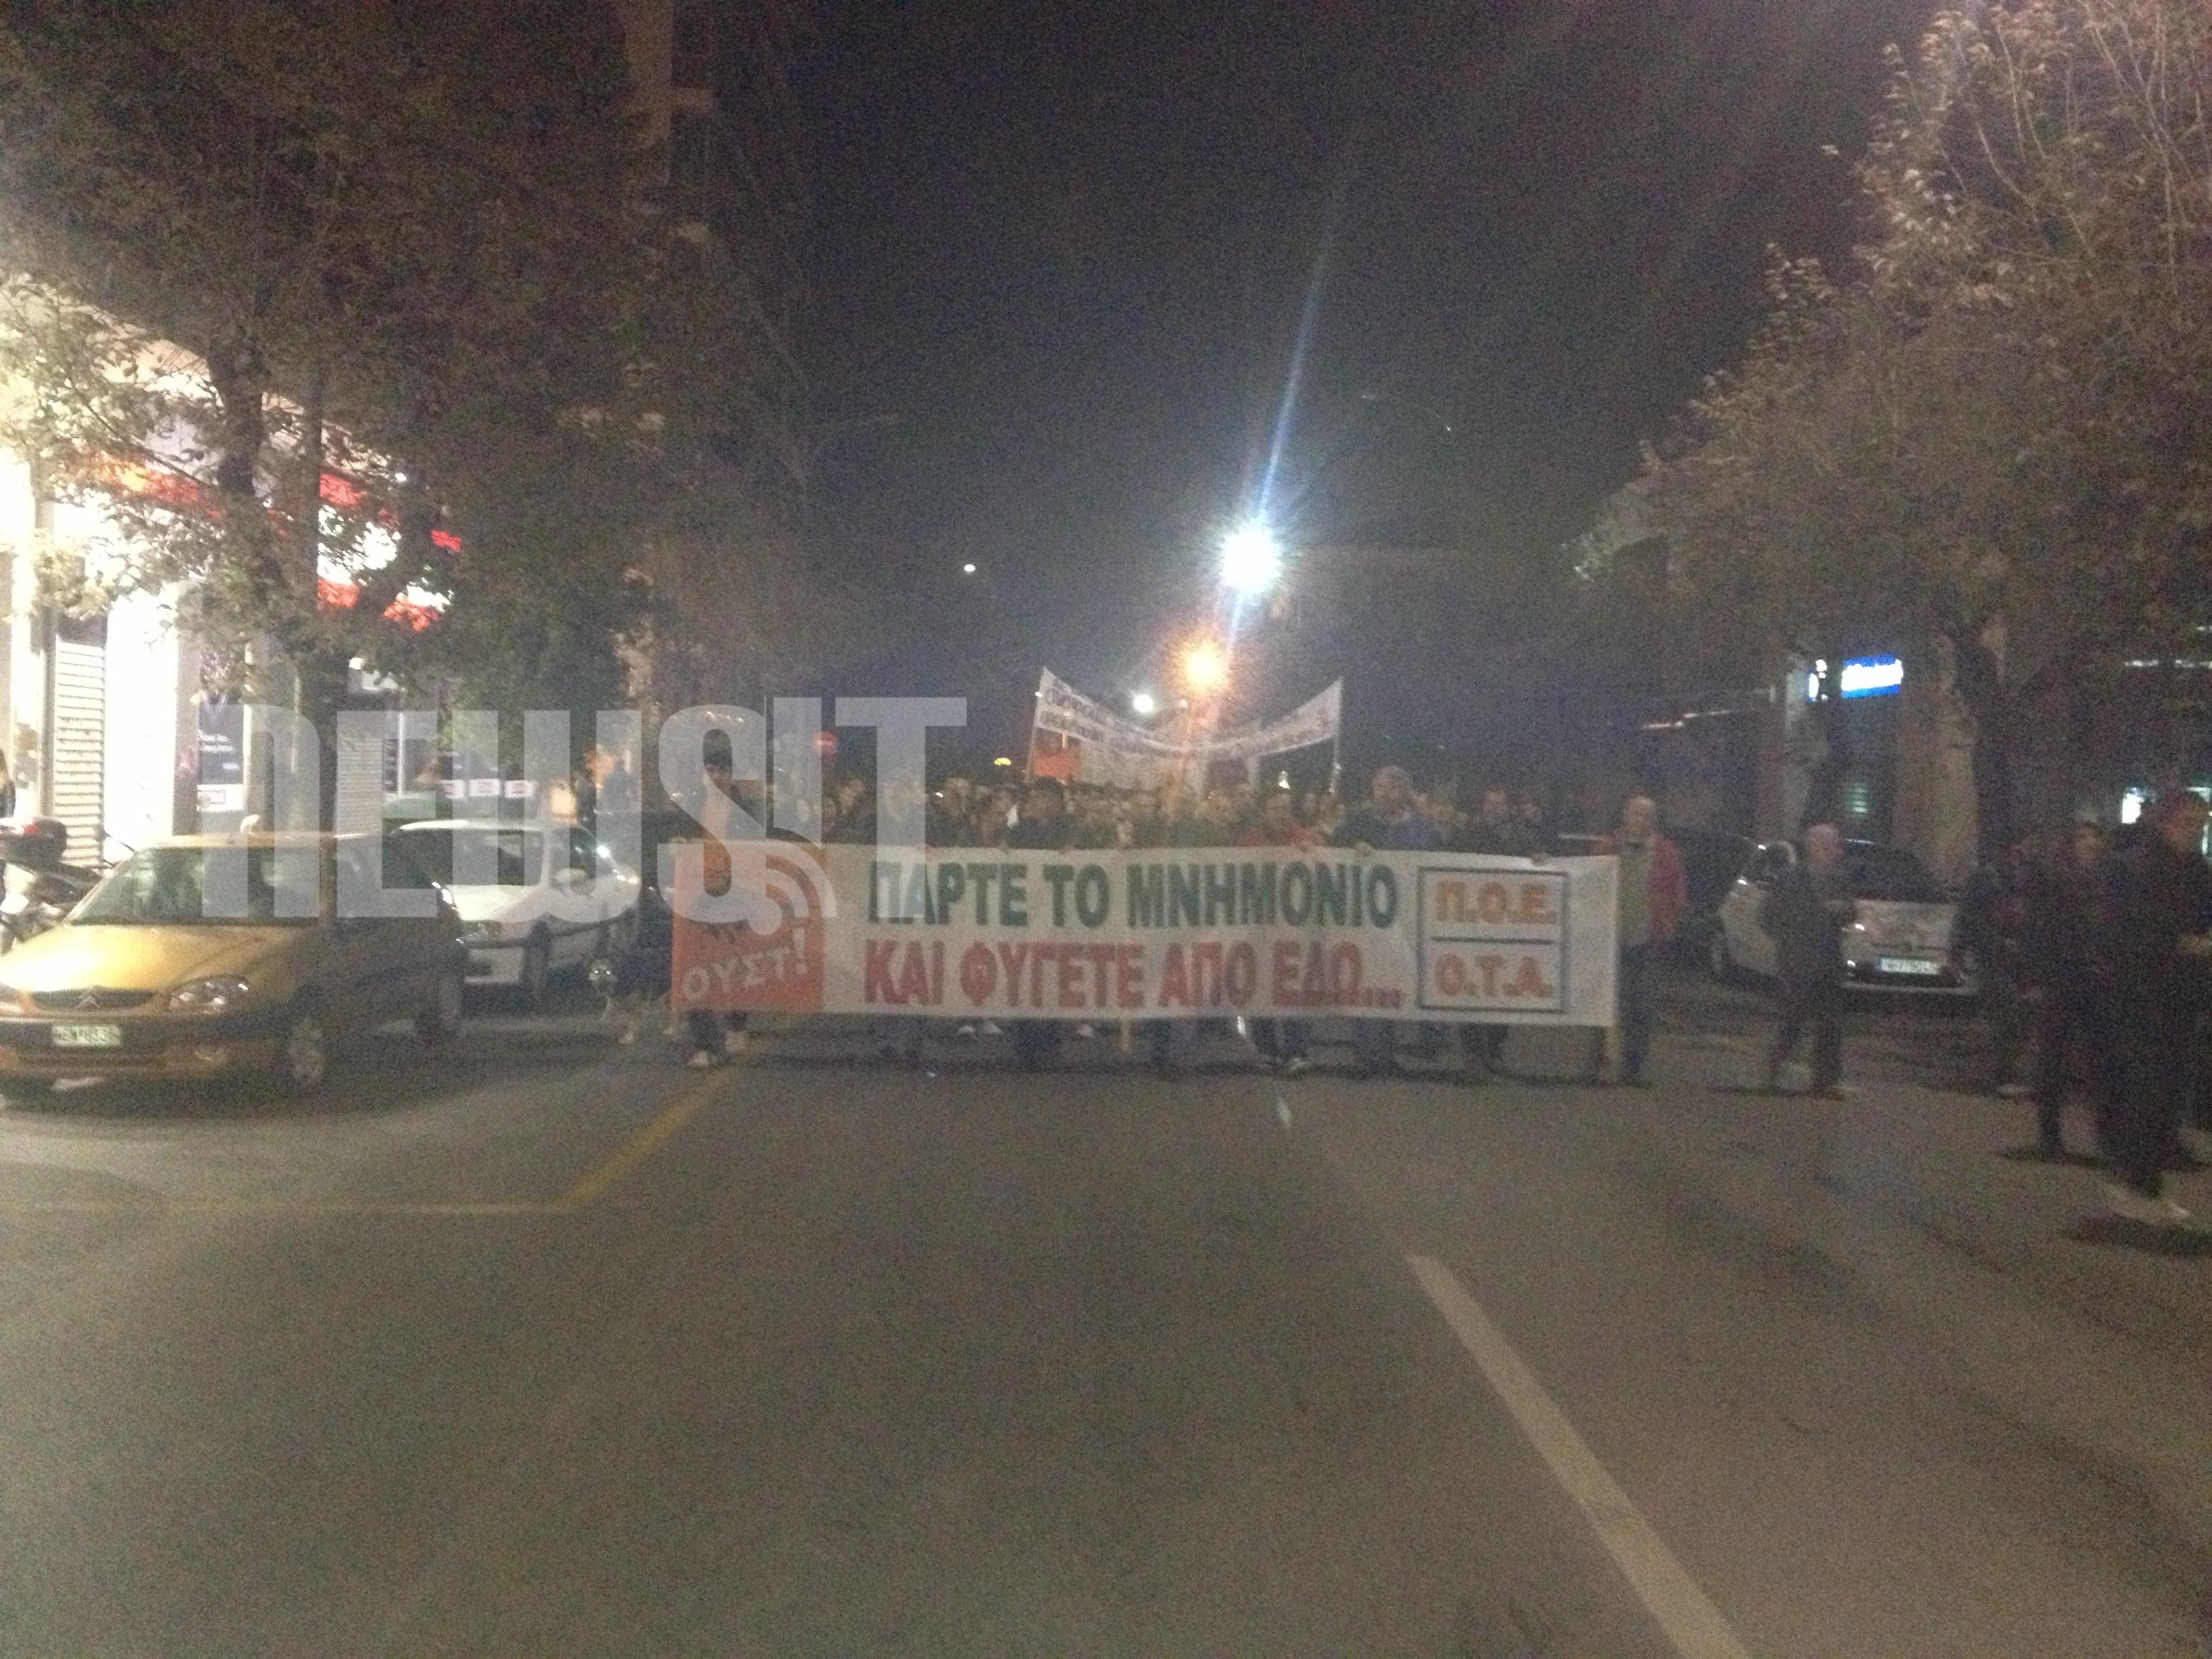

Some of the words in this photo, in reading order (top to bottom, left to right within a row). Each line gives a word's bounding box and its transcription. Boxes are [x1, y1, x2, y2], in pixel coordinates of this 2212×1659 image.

[867, 859, 1028, 927] ΠΑΡΤΕ
[1043, 863, 1109, 928] ΤΟ
[1125, 860, 1398, 929] ΜΝΗΜΟΝΙΟ
[863, 937, 945, 1006] ΚΑΙ
[959, 940, 1145, 1009] ΦΥΓΕΤΕ
[1156, 941, 1257, 1008] ΑΠΟ
